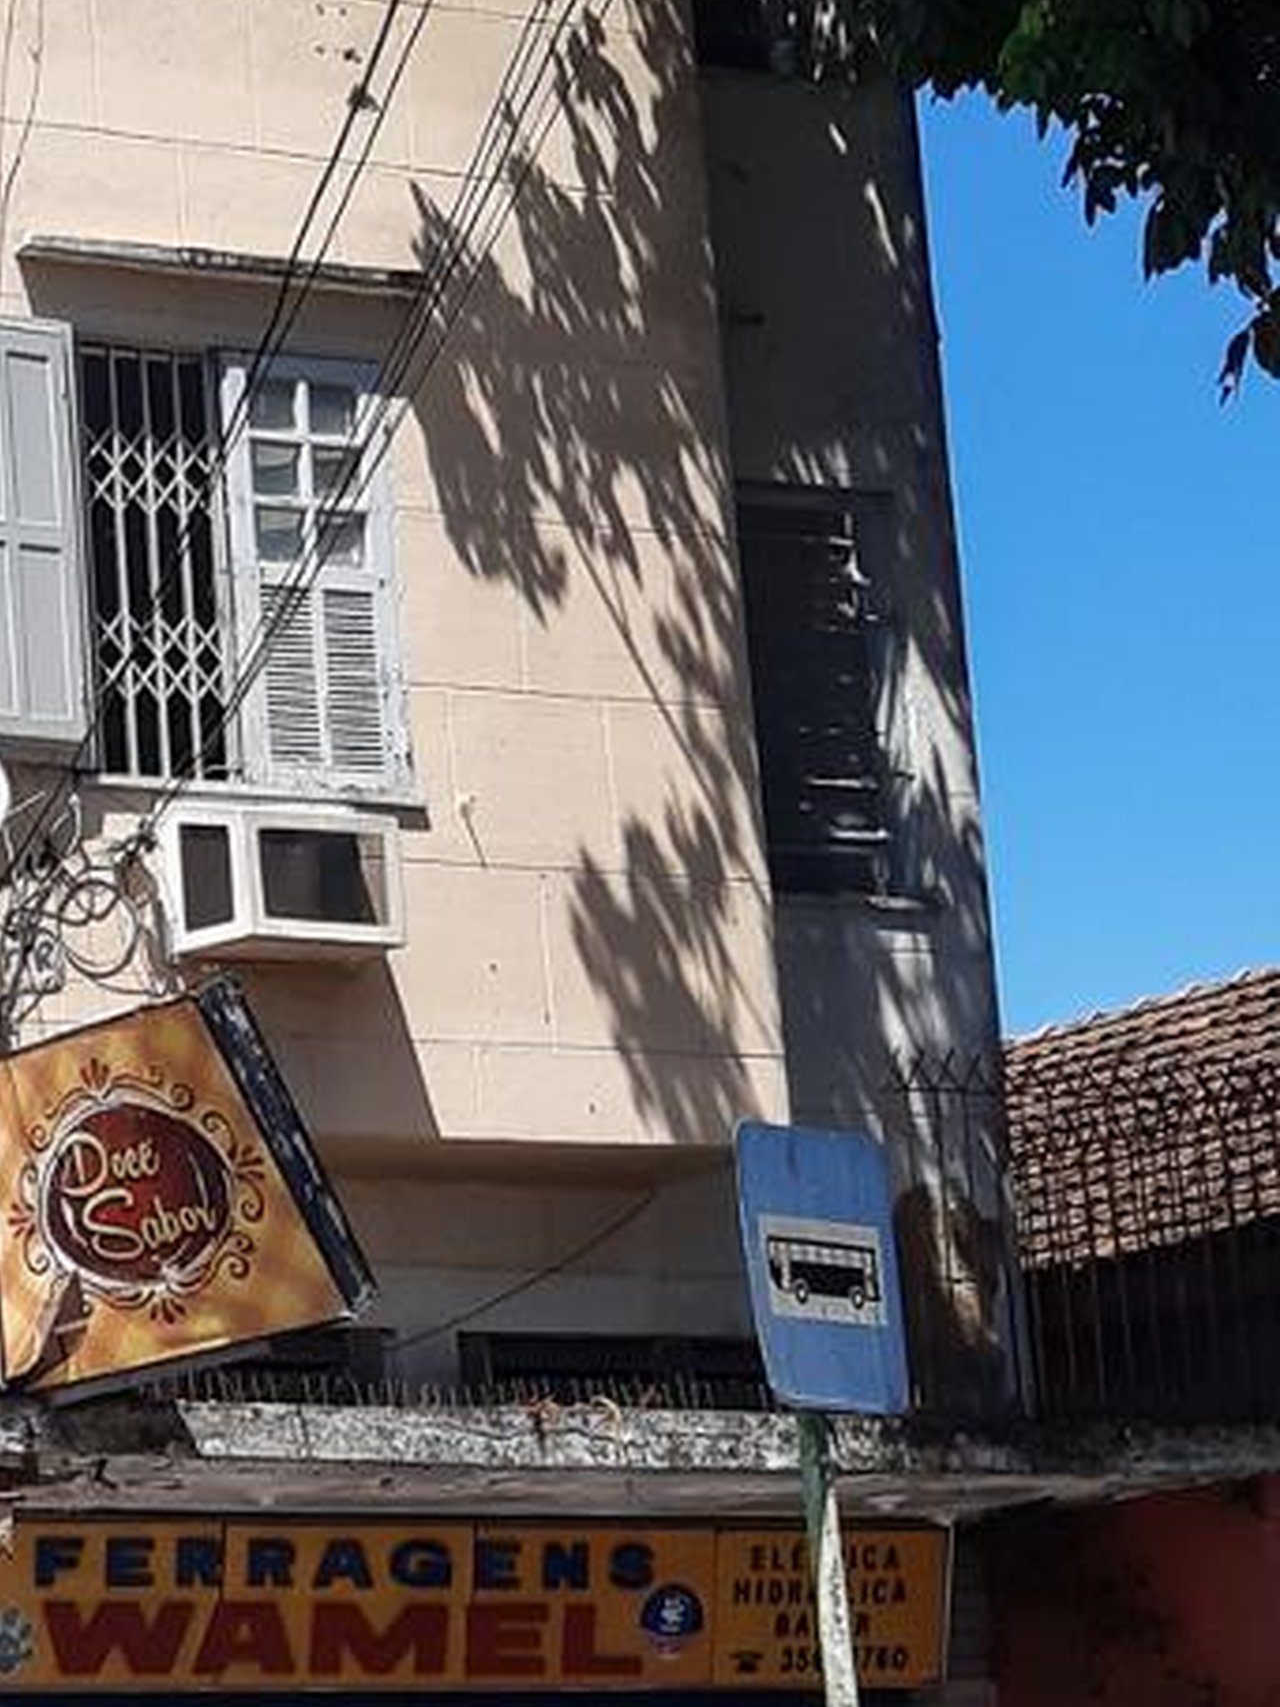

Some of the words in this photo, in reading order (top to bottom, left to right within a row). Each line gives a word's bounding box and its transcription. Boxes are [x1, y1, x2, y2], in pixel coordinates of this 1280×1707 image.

[64, 1130, 161, 1198] Doce
[82, 1186, 218, 1261] Sabor
[34, 1536, 656, 1590] FERRAGENS
[43, 1599, 643, 1678] WAMEL
